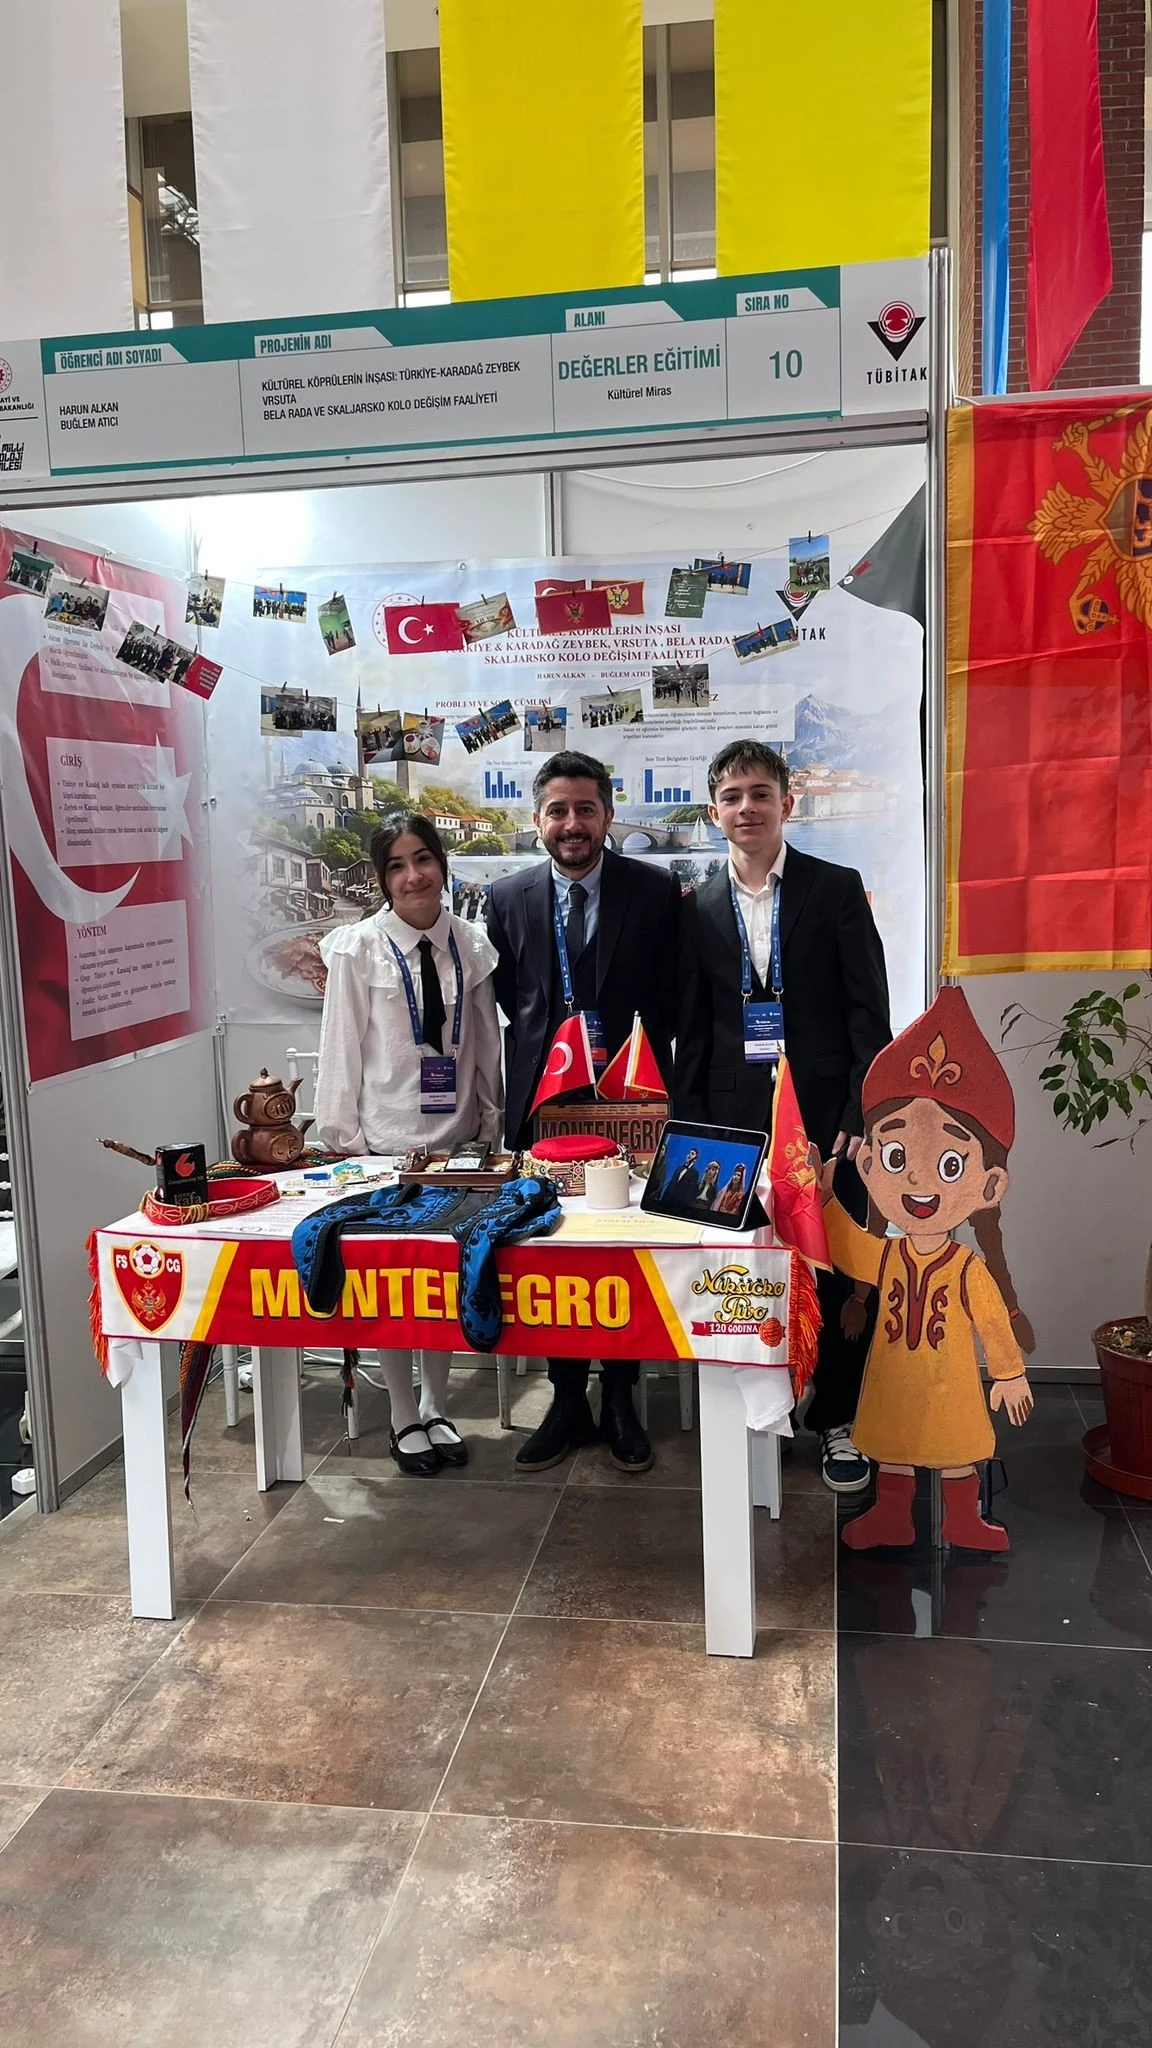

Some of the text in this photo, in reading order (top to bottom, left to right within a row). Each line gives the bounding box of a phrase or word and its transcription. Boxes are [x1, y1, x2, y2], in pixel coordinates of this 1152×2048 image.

[744, 293, 789, 312] SIRA NO
[573, 310, 605, 328] ALANI
[260, 333, 332, 354] PROJENİN ADI
[60, 348, 162, 370] ÖĞRENCİ ADI SOYADI
[558, 343, 721, 381] DEĞERLER EĞİTİMİ
[769, 349, 803, 379] 10
[261, 361, 521, 392] KÜLTÜREL KÖPRÜLERİN İNŞASI: TÜRKİYE-KARADAĞ ZEYBEK
[866, 366, 928, 386] TÜBİTAK
[262, 394, 297, 406] VRSUTA
[607, 384, 672, 400] Kültürel Miras
[59, 402, 119, 416] HARUN ALKAN
[263, 391, 498, 421] BELA RADA VE SKALJARSKO KOLO DEĞİŞİM FAALİYETİ
[61, 416, 119, 430] BUĞLEM ATICI
[2, 442, 24, 453] MİLLİ
[645, 624, 681, 636] İNŞASI
[495, 643, 503, 651] &
[506, 639, 560, 651] KARADAĞ
[562, 638, 611, 650] ZEYBEK,
[613, 638, 658, 648] VRSUTA
[666, 637, 696, 647] BELA
[699, 636, 730, 645] RADA
[484, 647, 705, 665] SKALJARSKO KOLO DEĞİŞİM FAALİYETİ
[537, 672, 561, 680] HARUN
[562, 671, 586, 679] ALKAN
[600, 670, 631, 679] BUĞLEM
[632, 670, 650, 678] ATICI
[435, 700, 477, 709] PROBLEM
[478, 700, 488, 708] VE
[60, 753, 83, 769] GİRİŞ
[77, 925, 107, 940] YÖNTEM
[115, 1254, 180, 1273] FS CG
[714, 1294, 768, 1324] Pivo
[709, 1323, 758, 1333] 120 GODINA
